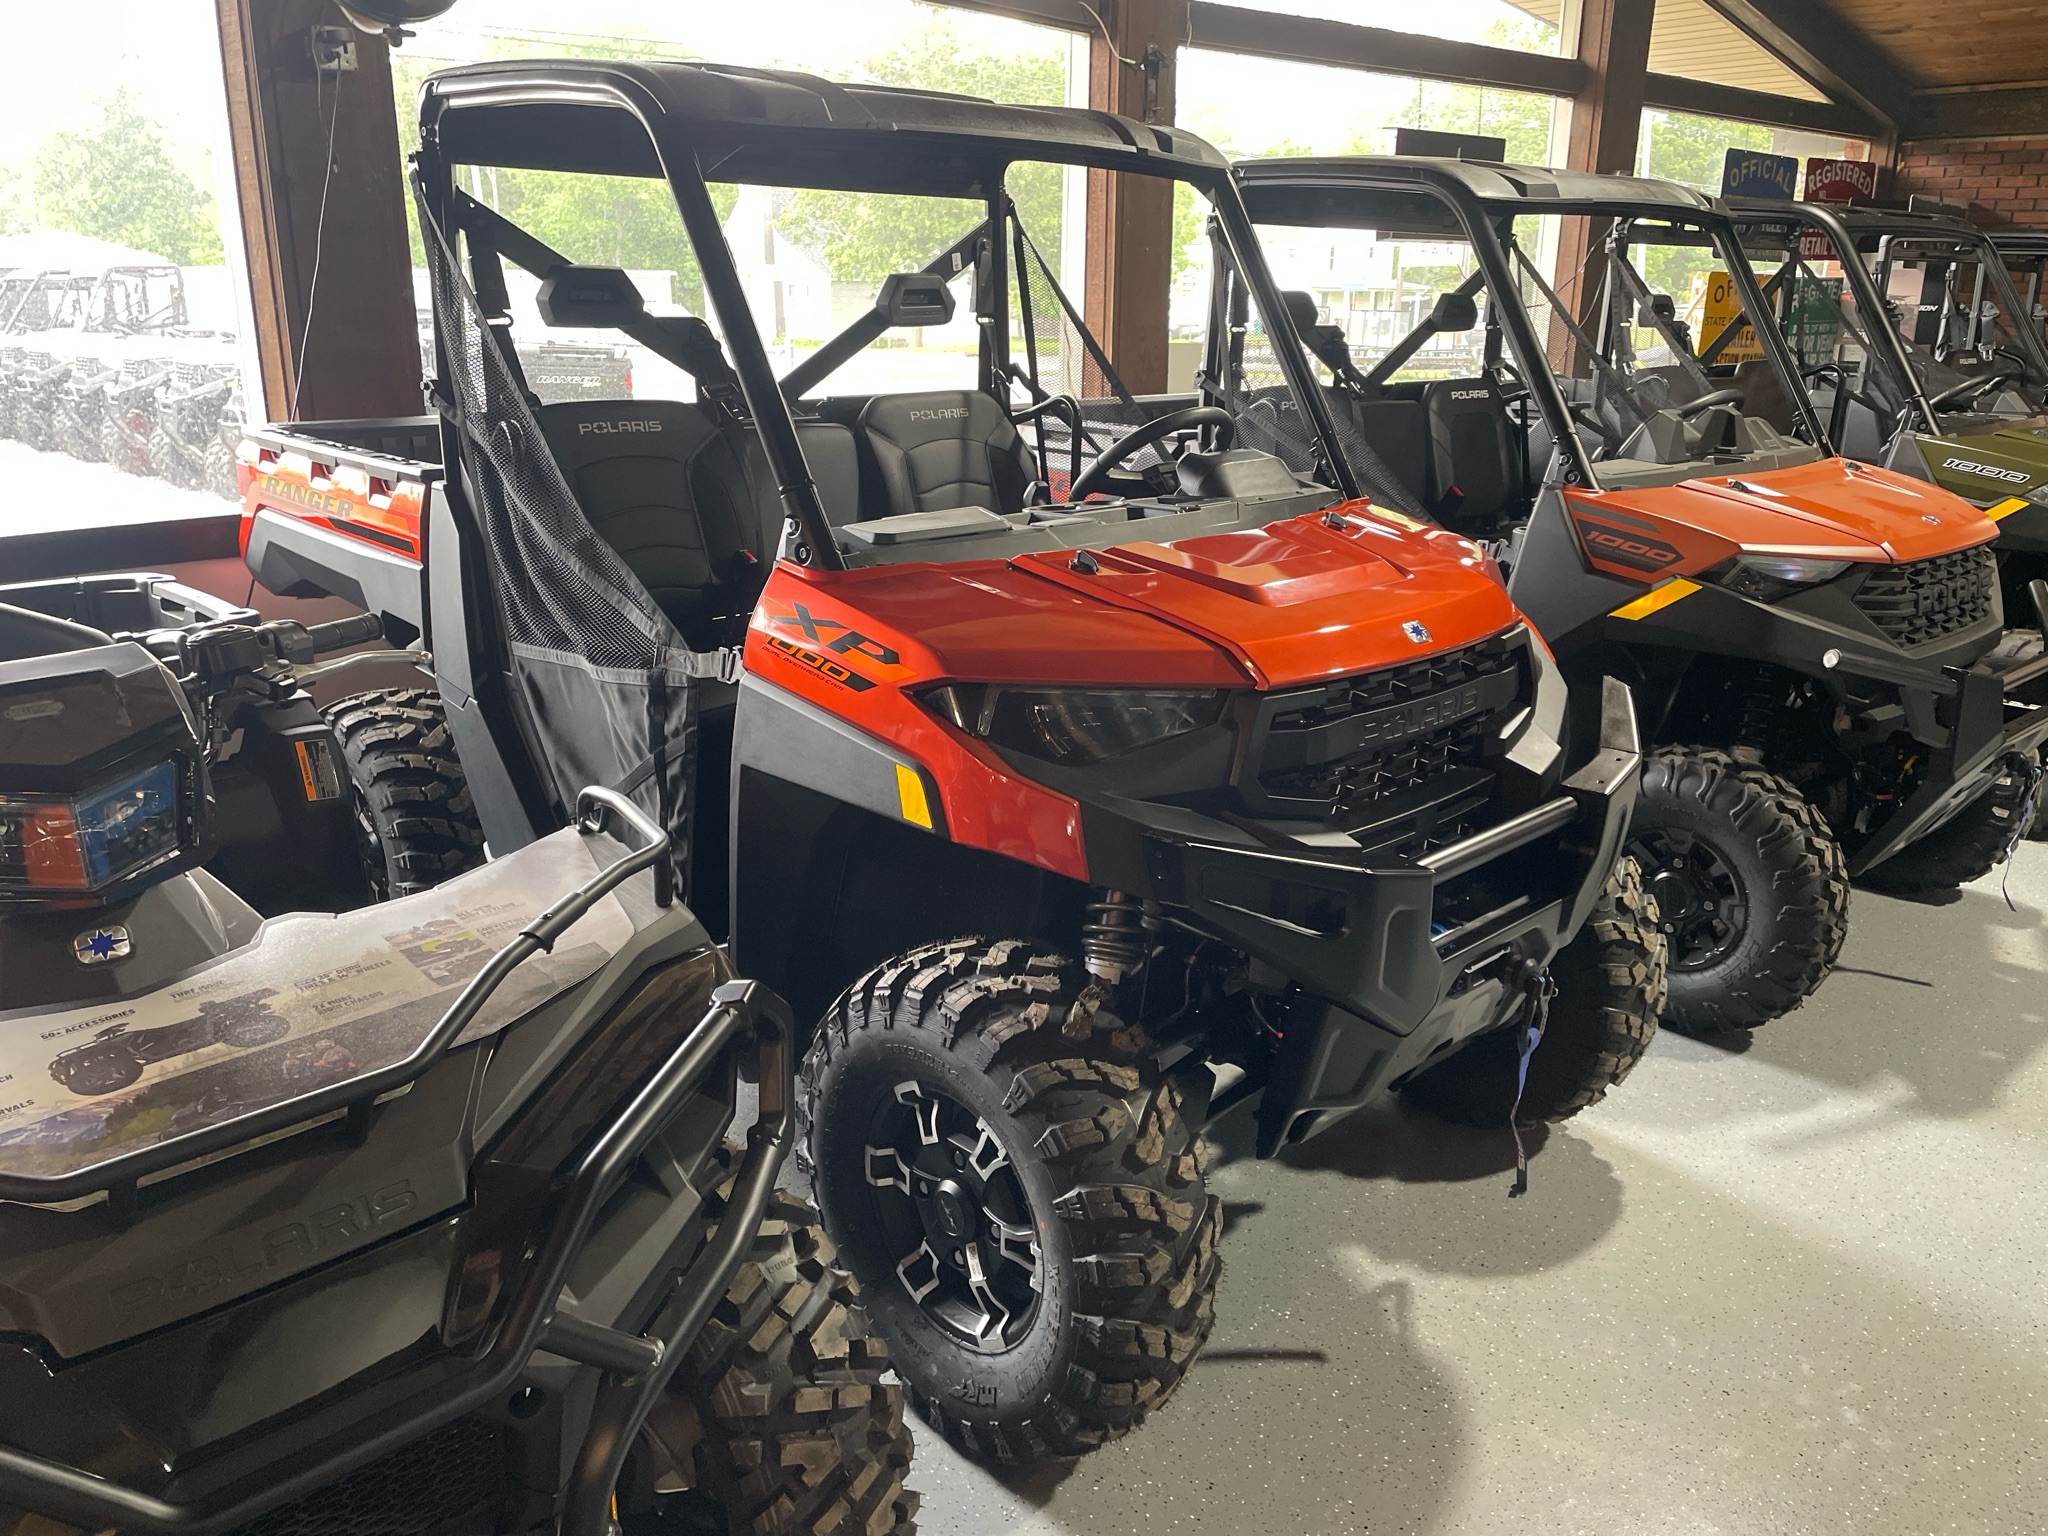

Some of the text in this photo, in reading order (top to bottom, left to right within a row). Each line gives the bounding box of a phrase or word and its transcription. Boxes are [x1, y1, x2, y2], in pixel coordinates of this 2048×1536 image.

[1730, 157, 1790, 194] OFFICIAL
[1808, 162, 1872, 195] REGISTERED
[1800, 236, 1829, 256] RETAIL
[1704, 316, 1727, 326] STATE
[1451, 389, 1489, 400] POLARIS
[578, 420, 663, 435] POLARIS
[910, 407, 969, 421] POLARIS
[1943, 458, 2031, 484] 1000
[265, 475, 355, 519] RANGER
[1586, 531, 1677, 562] 1000
[768, 600, 901, 666] XP
[761, 645, 845, 692] DUAL OVERHEAD CAM
[764, 634, 851, 683] 1000
[1358, 688, 1478, 748] POLARIS
[355, 960, 392, 974] WHEELS
[344, 990, 384, 1007] CHASSIS
[65, 1008, 136, 1035] ACCESSORIES
[108, 1178, 419, 1328] POLARIS
[766, 1256, 794, 1274] DURO
